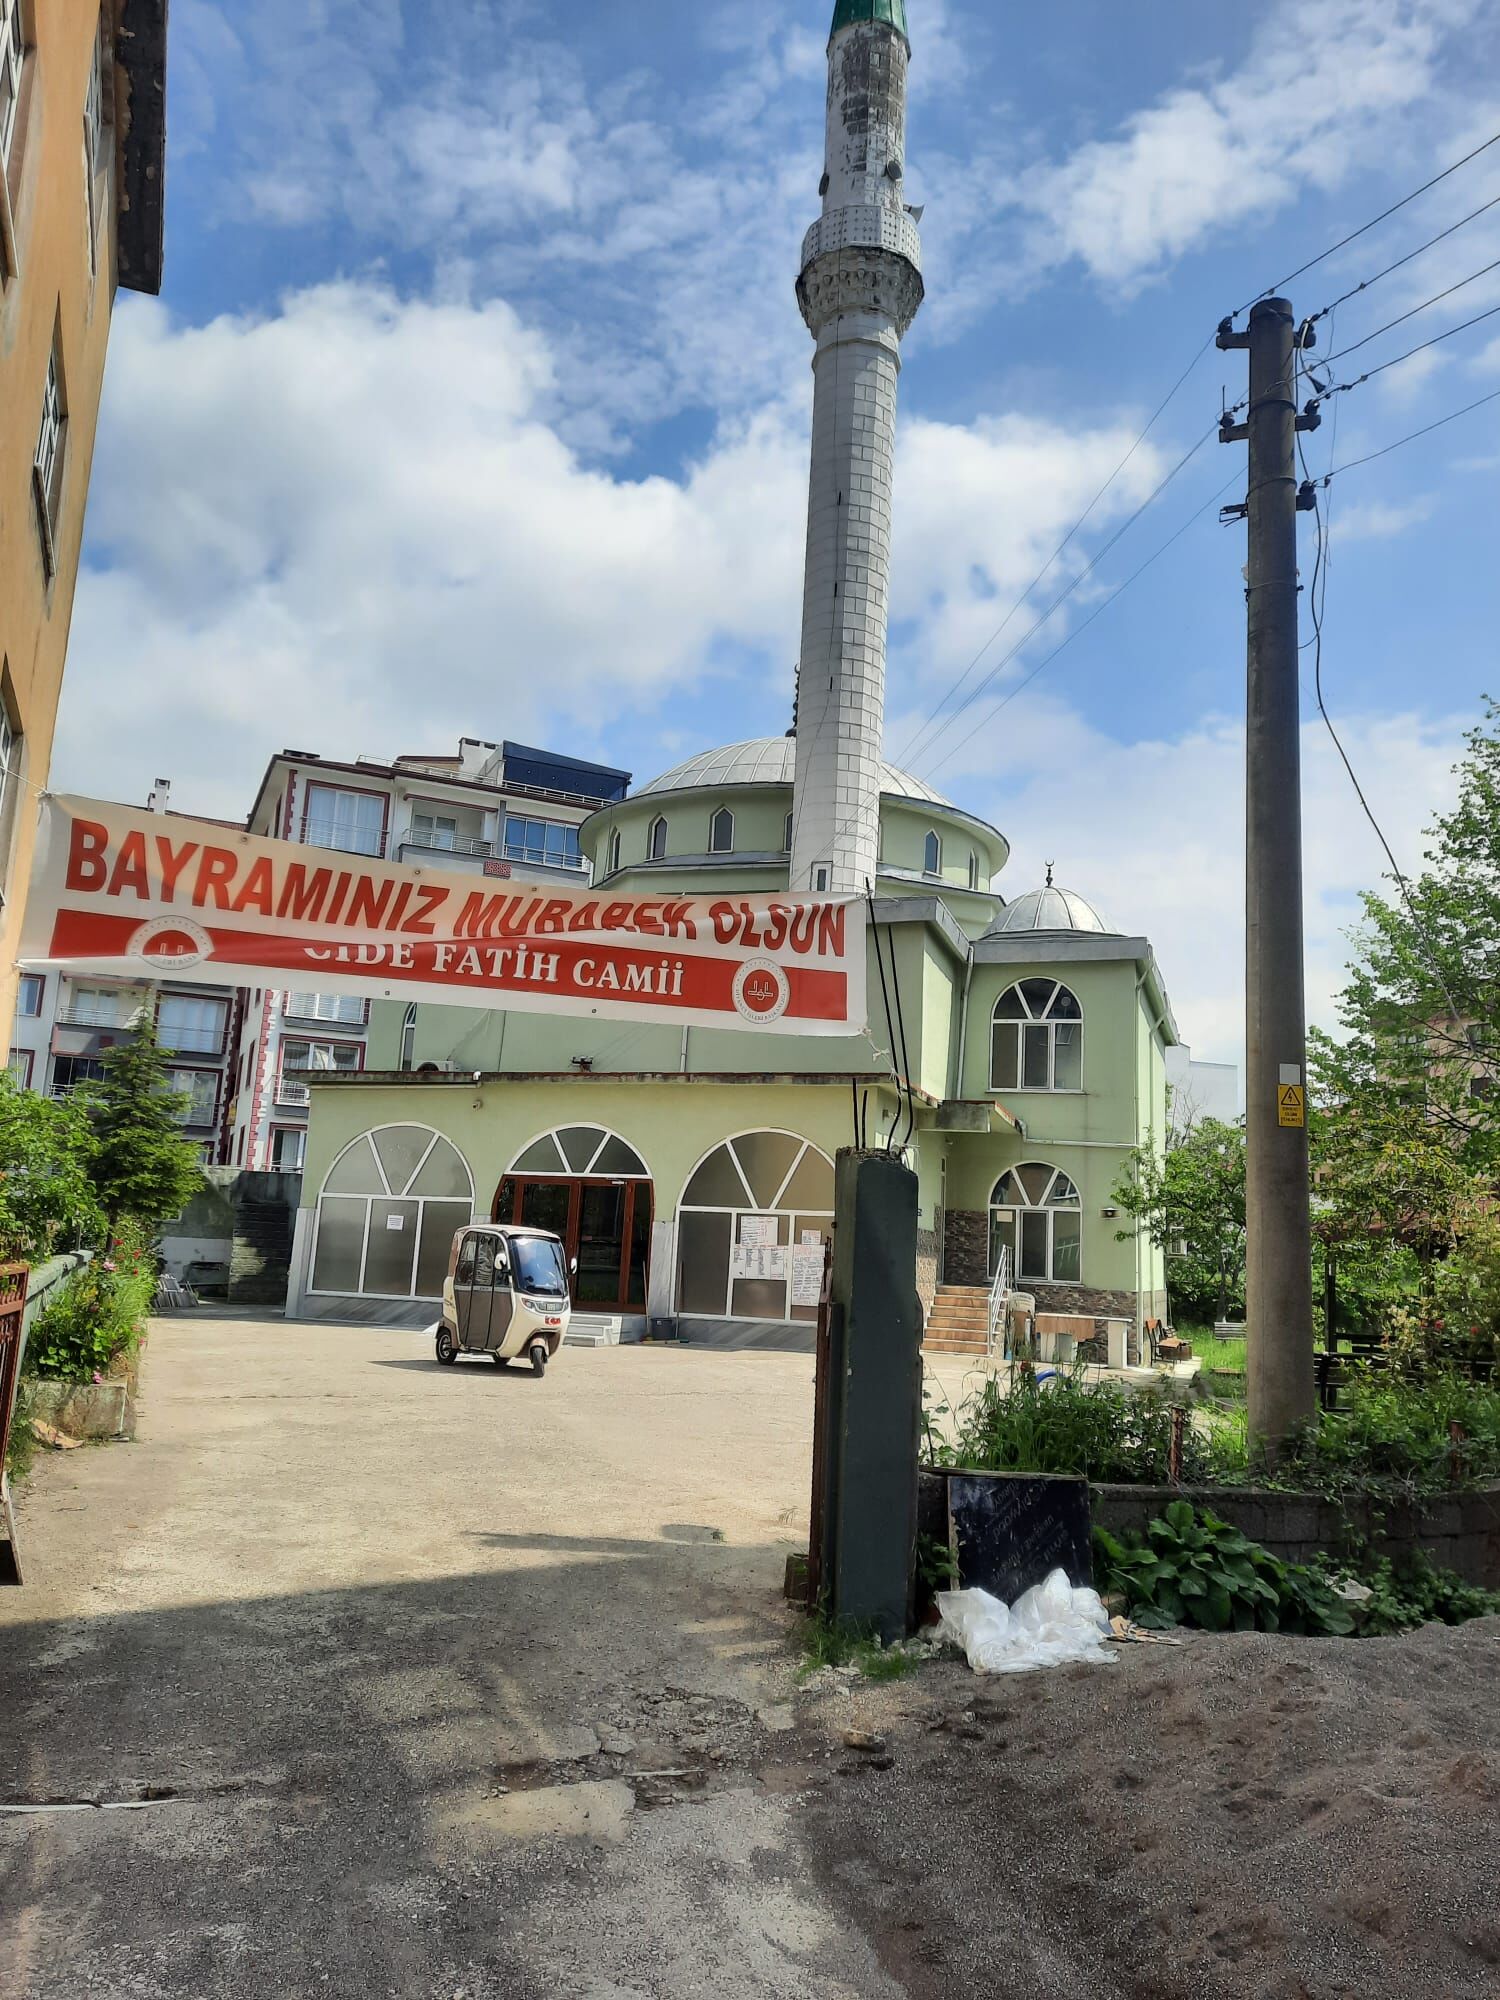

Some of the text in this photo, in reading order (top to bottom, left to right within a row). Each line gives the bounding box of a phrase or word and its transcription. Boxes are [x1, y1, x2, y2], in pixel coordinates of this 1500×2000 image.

[65, 817, 451, 935] BAYRAMINIZ
[708, 901, 846, 957] OLSUN
[431, 943, 561, 982] FATİH
[572, 959, 684, 996] CAMİİ
